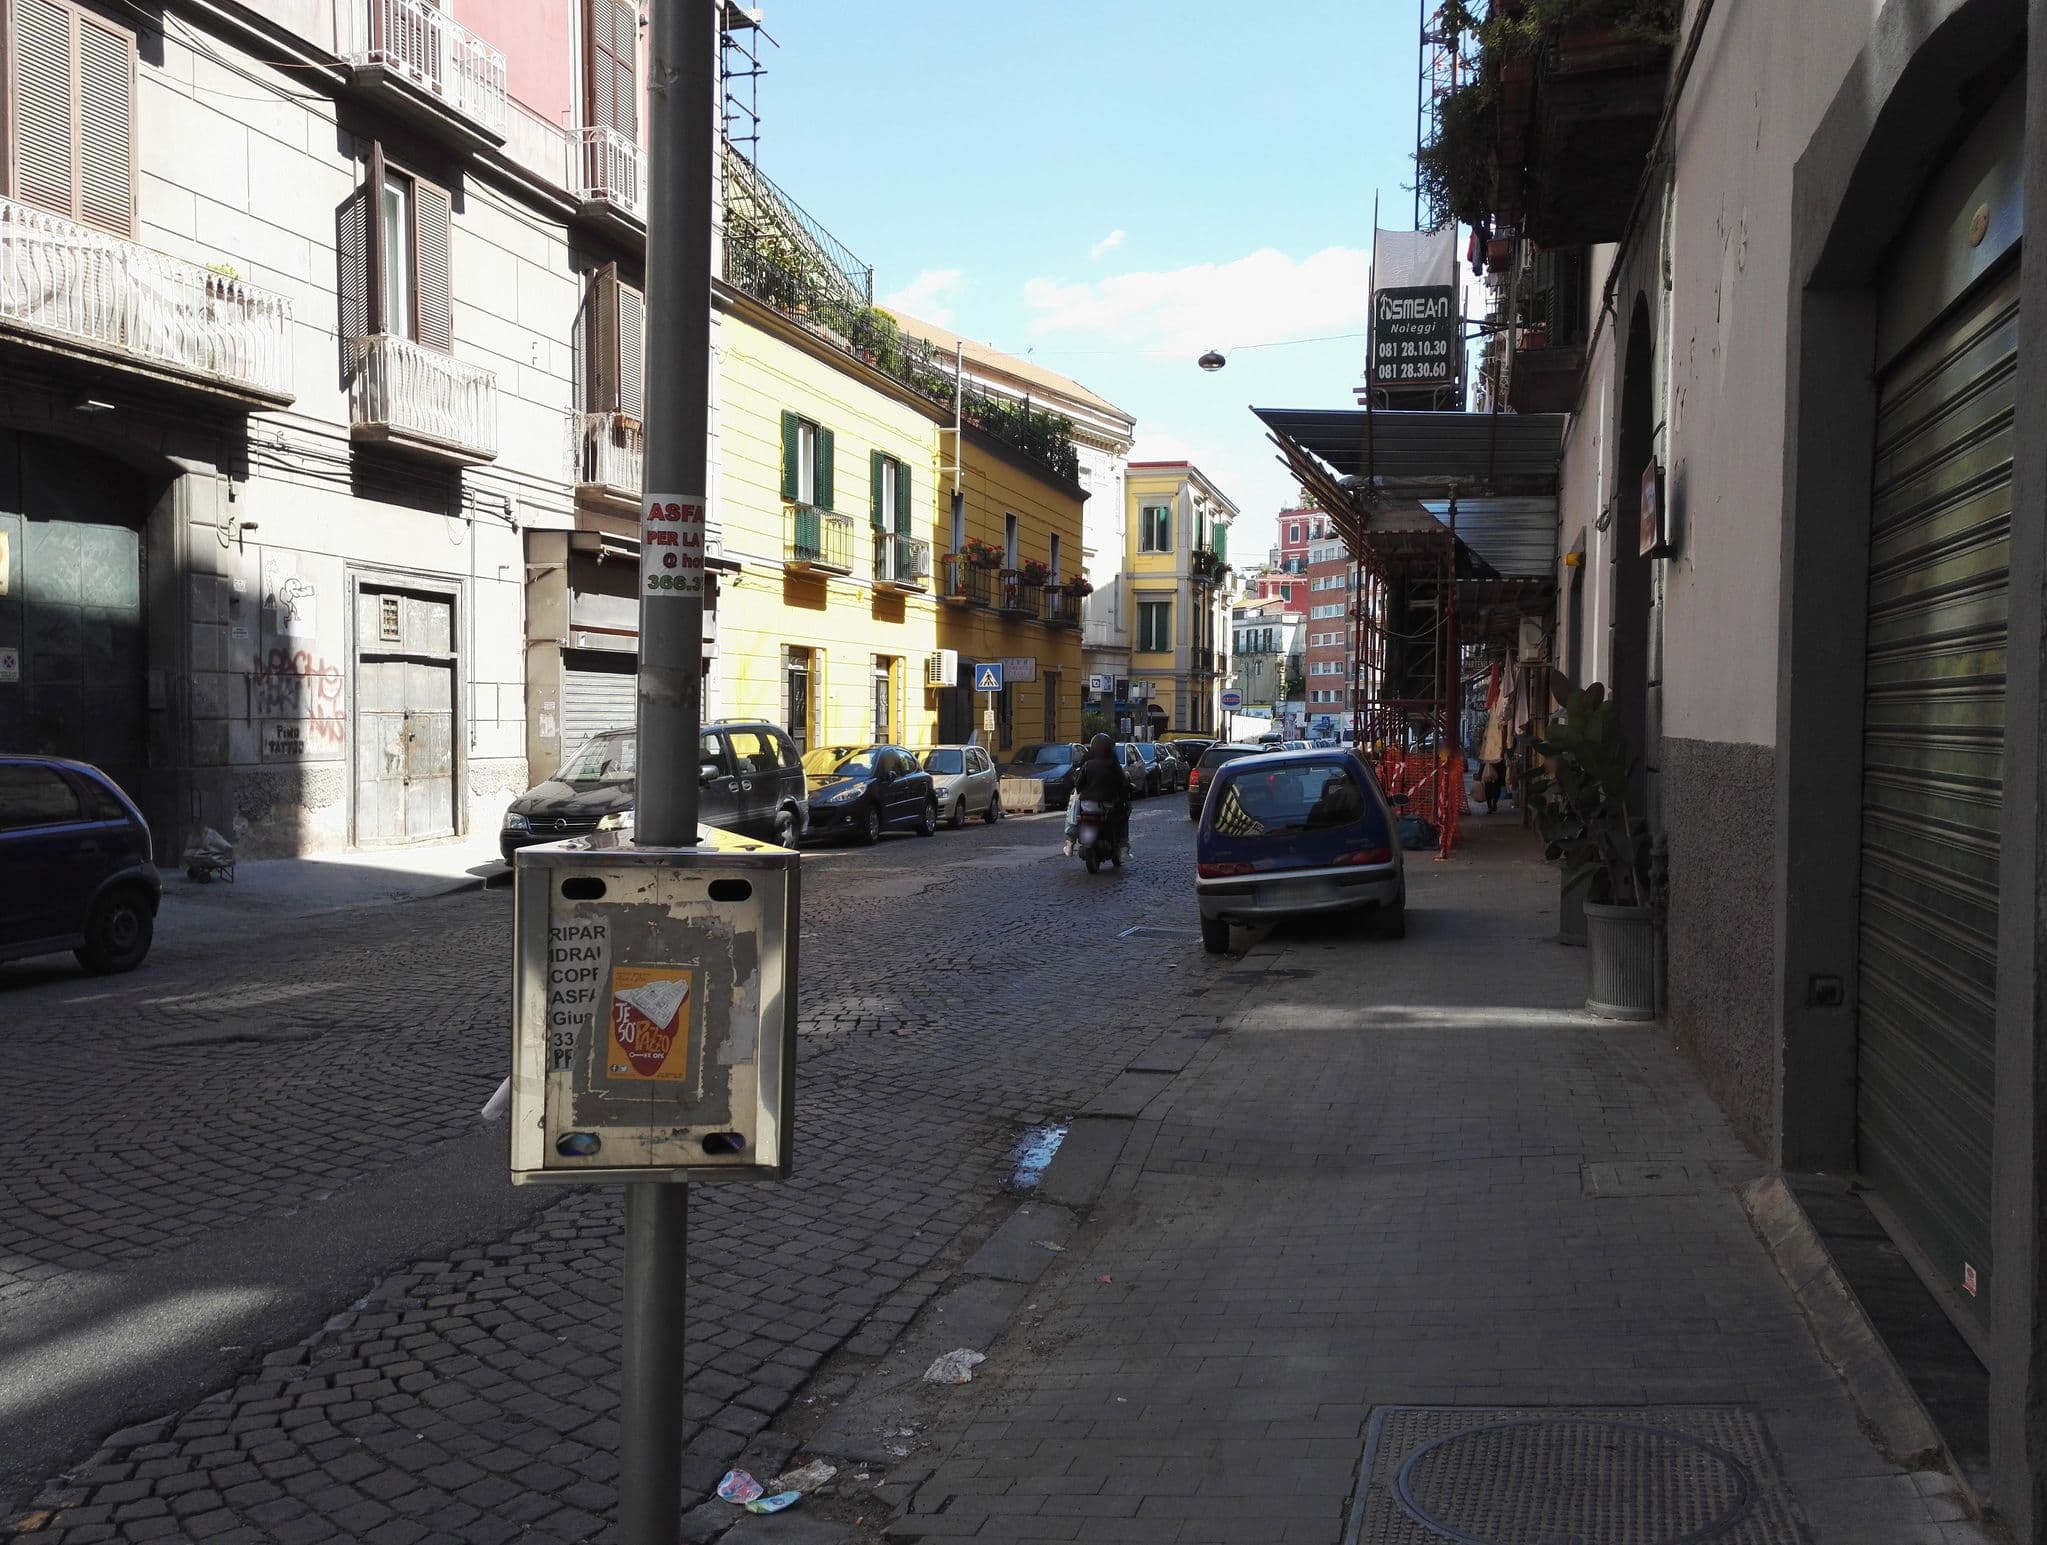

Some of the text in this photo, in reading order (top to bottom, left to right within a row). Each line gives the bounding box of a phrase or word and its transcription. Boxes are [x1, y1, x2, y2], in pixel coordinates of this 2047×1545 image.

[1391, 322, 1436, 335] Noleggi
[1379, 340, 1447, 357] 081 28.10.30
[1378, 362, 1446, 379] 081 28.30.60
[647, 530, 700, 547] PER LA
[648, 574, 704, 591] 366.3
[550, 925, 606, 942] RIPAR
[615, 1002, 631, 1023] JE
[553, 1032, 574, 1047] 33
